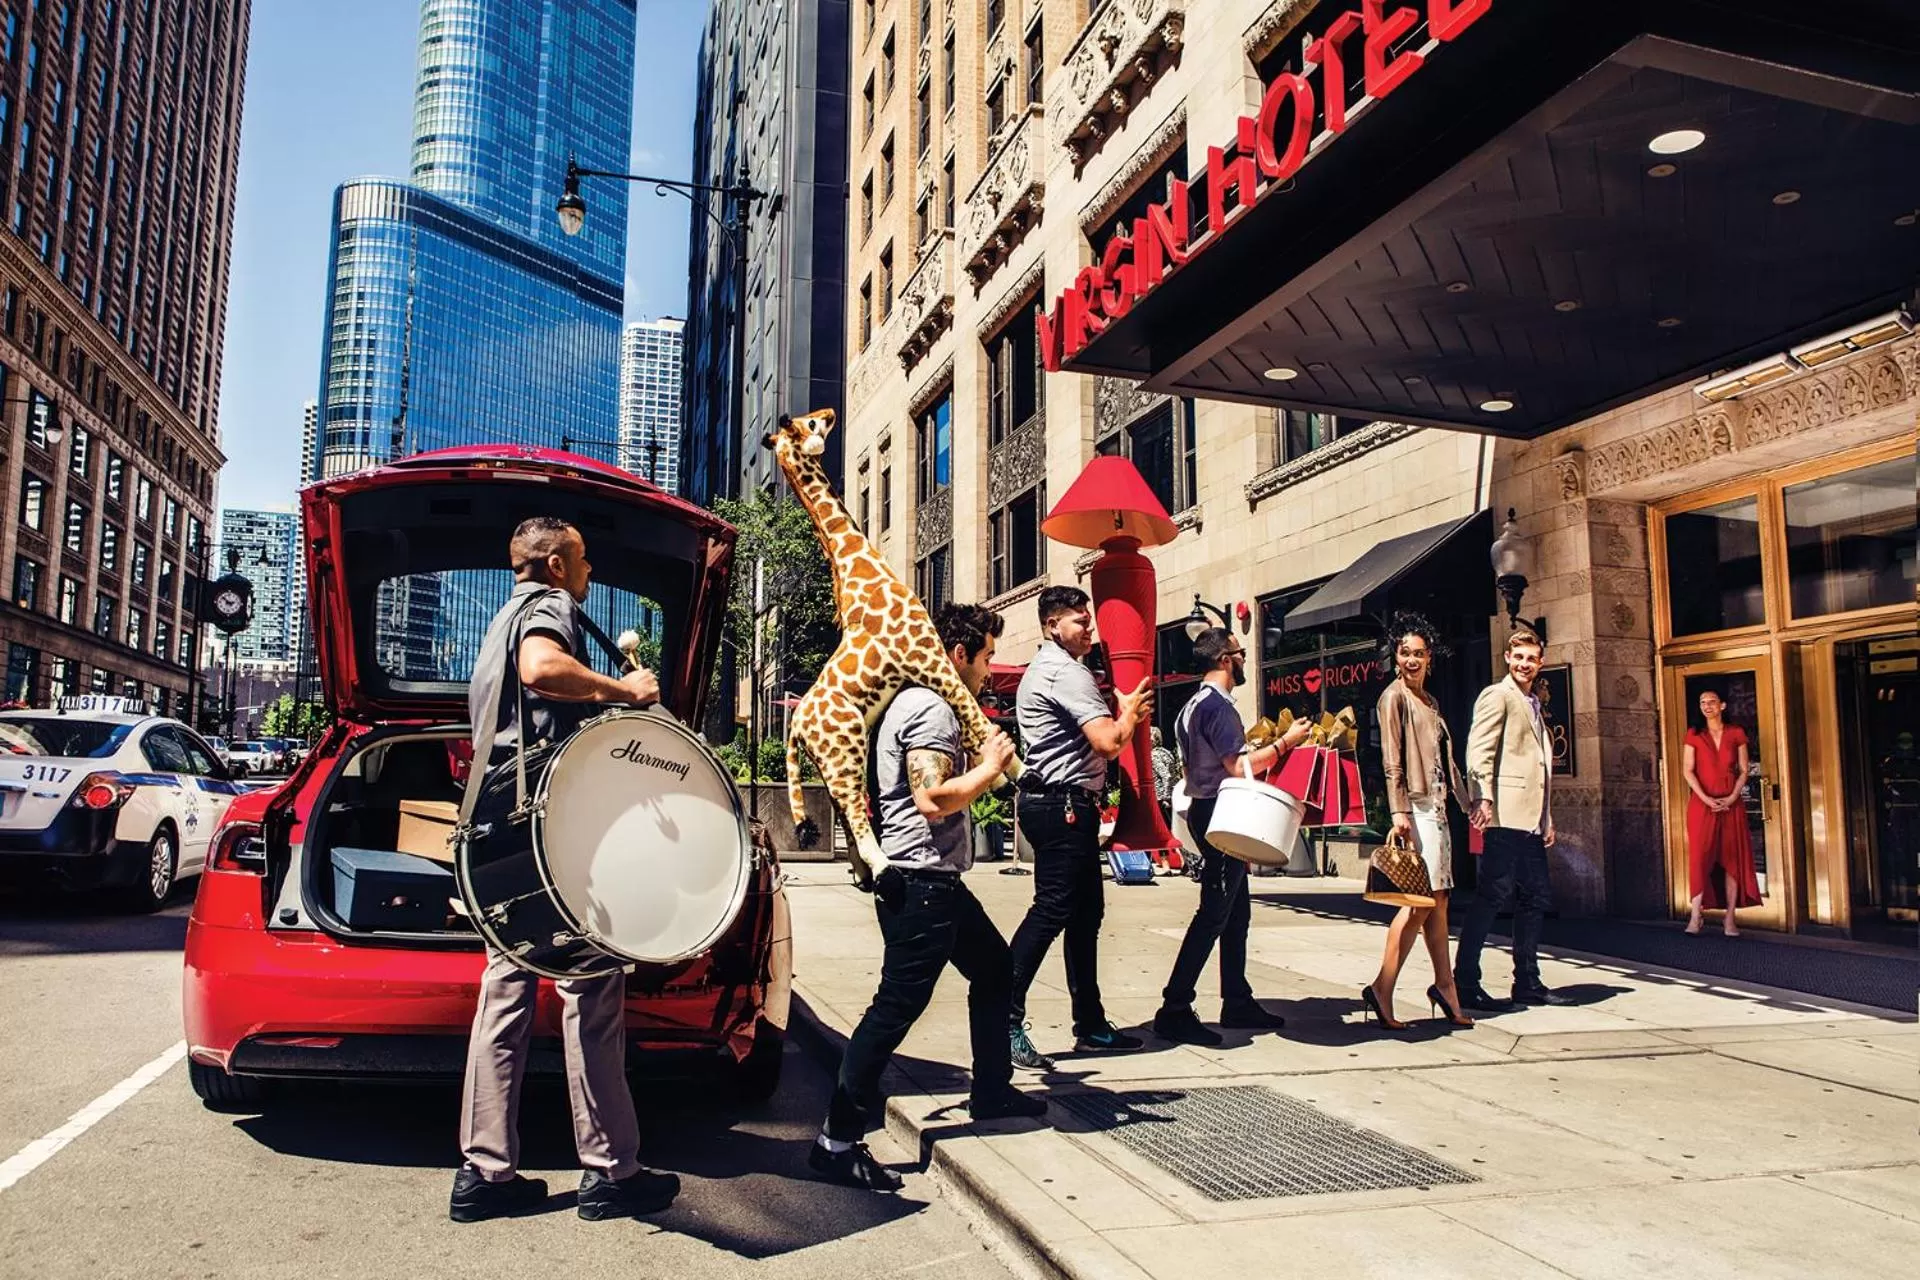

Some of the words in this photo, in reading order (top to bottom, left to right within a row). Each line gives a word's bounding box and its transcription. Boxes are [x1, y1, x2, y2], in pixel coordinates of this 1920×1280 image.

[1036, 179, 1188, 372] VIRGIN
[1268, 674, 1301, 696] MISS
[1325, 660, 1386, 689] RICKY'S
[60, 696, 80, 711] TAXI
[81, 696, 120, 711] 3117
[123, 699, 144, 713] TAXI
[22, 764, 72, 783] 3117
[610, 739, 691, 782] Harmony
